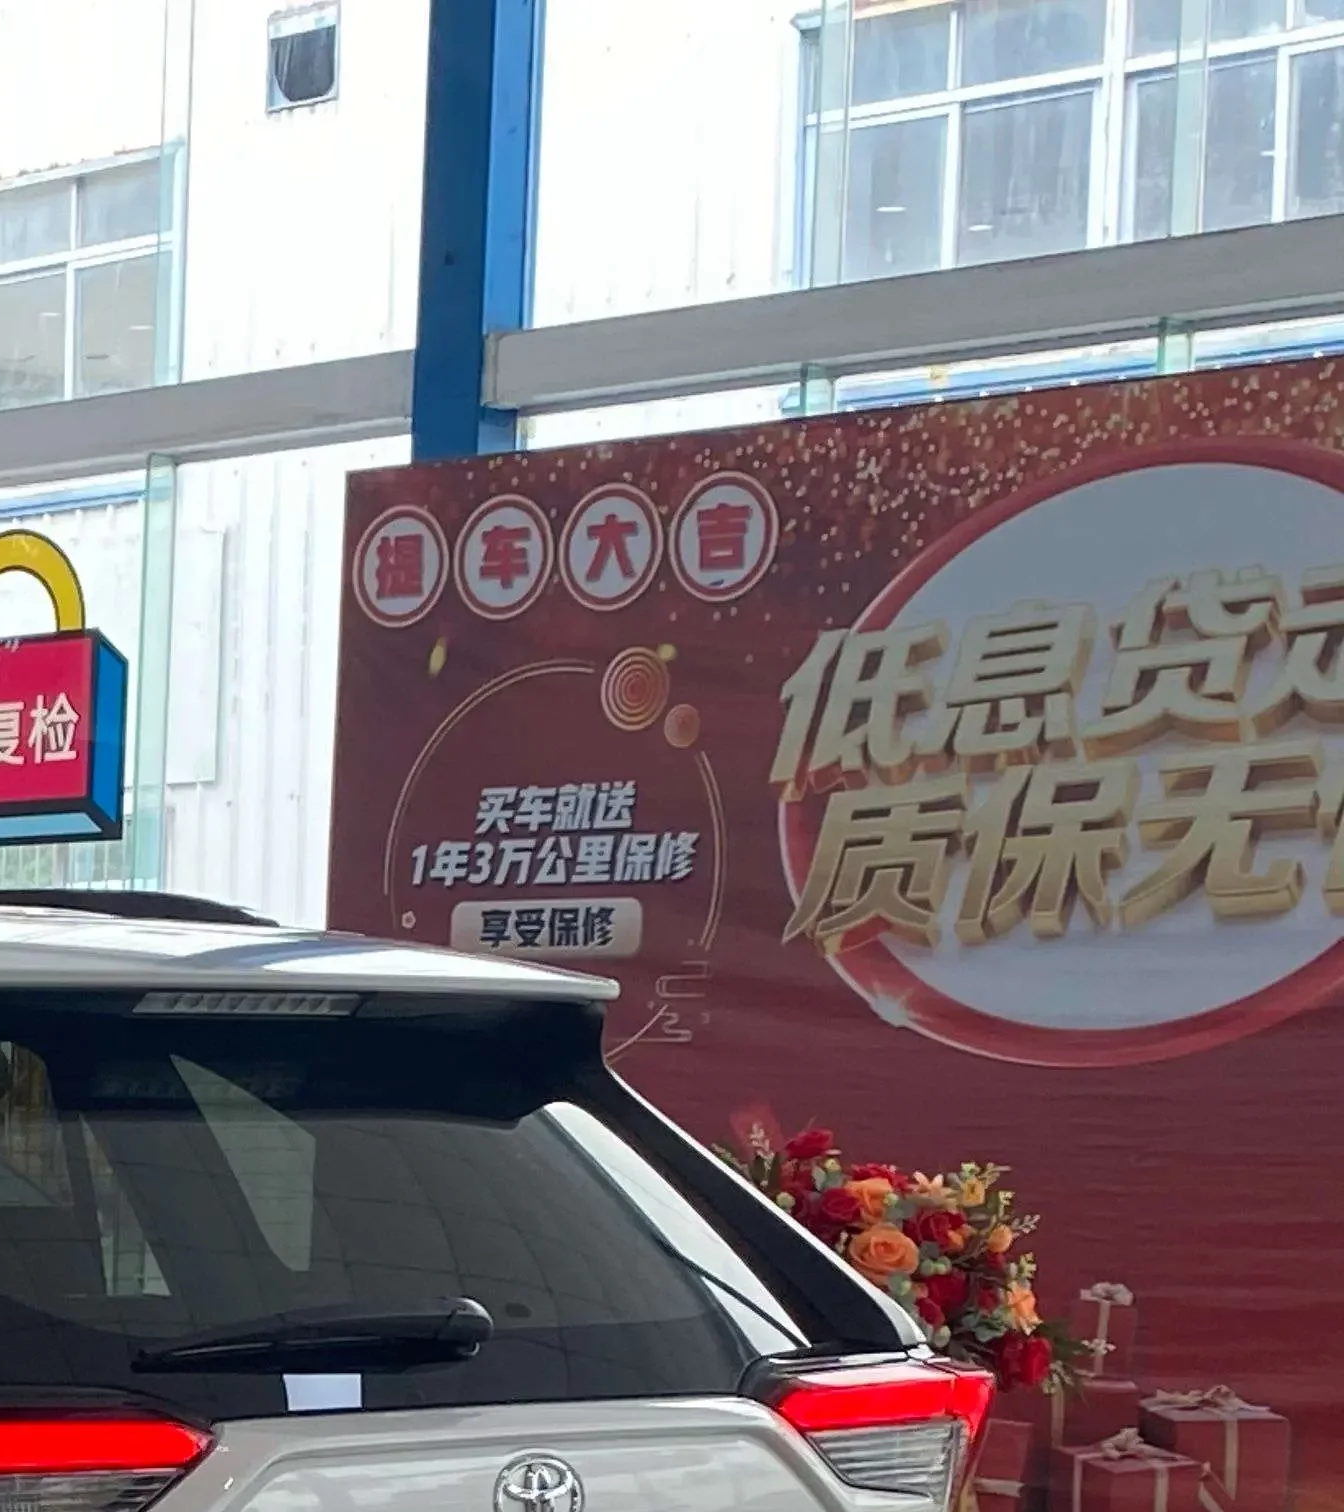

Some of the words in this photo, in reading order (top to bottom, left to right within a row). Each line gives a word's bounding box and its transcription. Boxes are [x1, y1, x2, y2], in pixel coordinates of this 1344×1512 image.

[474, 780, 637, 835] 买车就送
[411, 831, 701, 887] 1年3万公里保修
[782, 742, 1344, 950] 质保无
[480, 906, 616, 948] 享受保修
